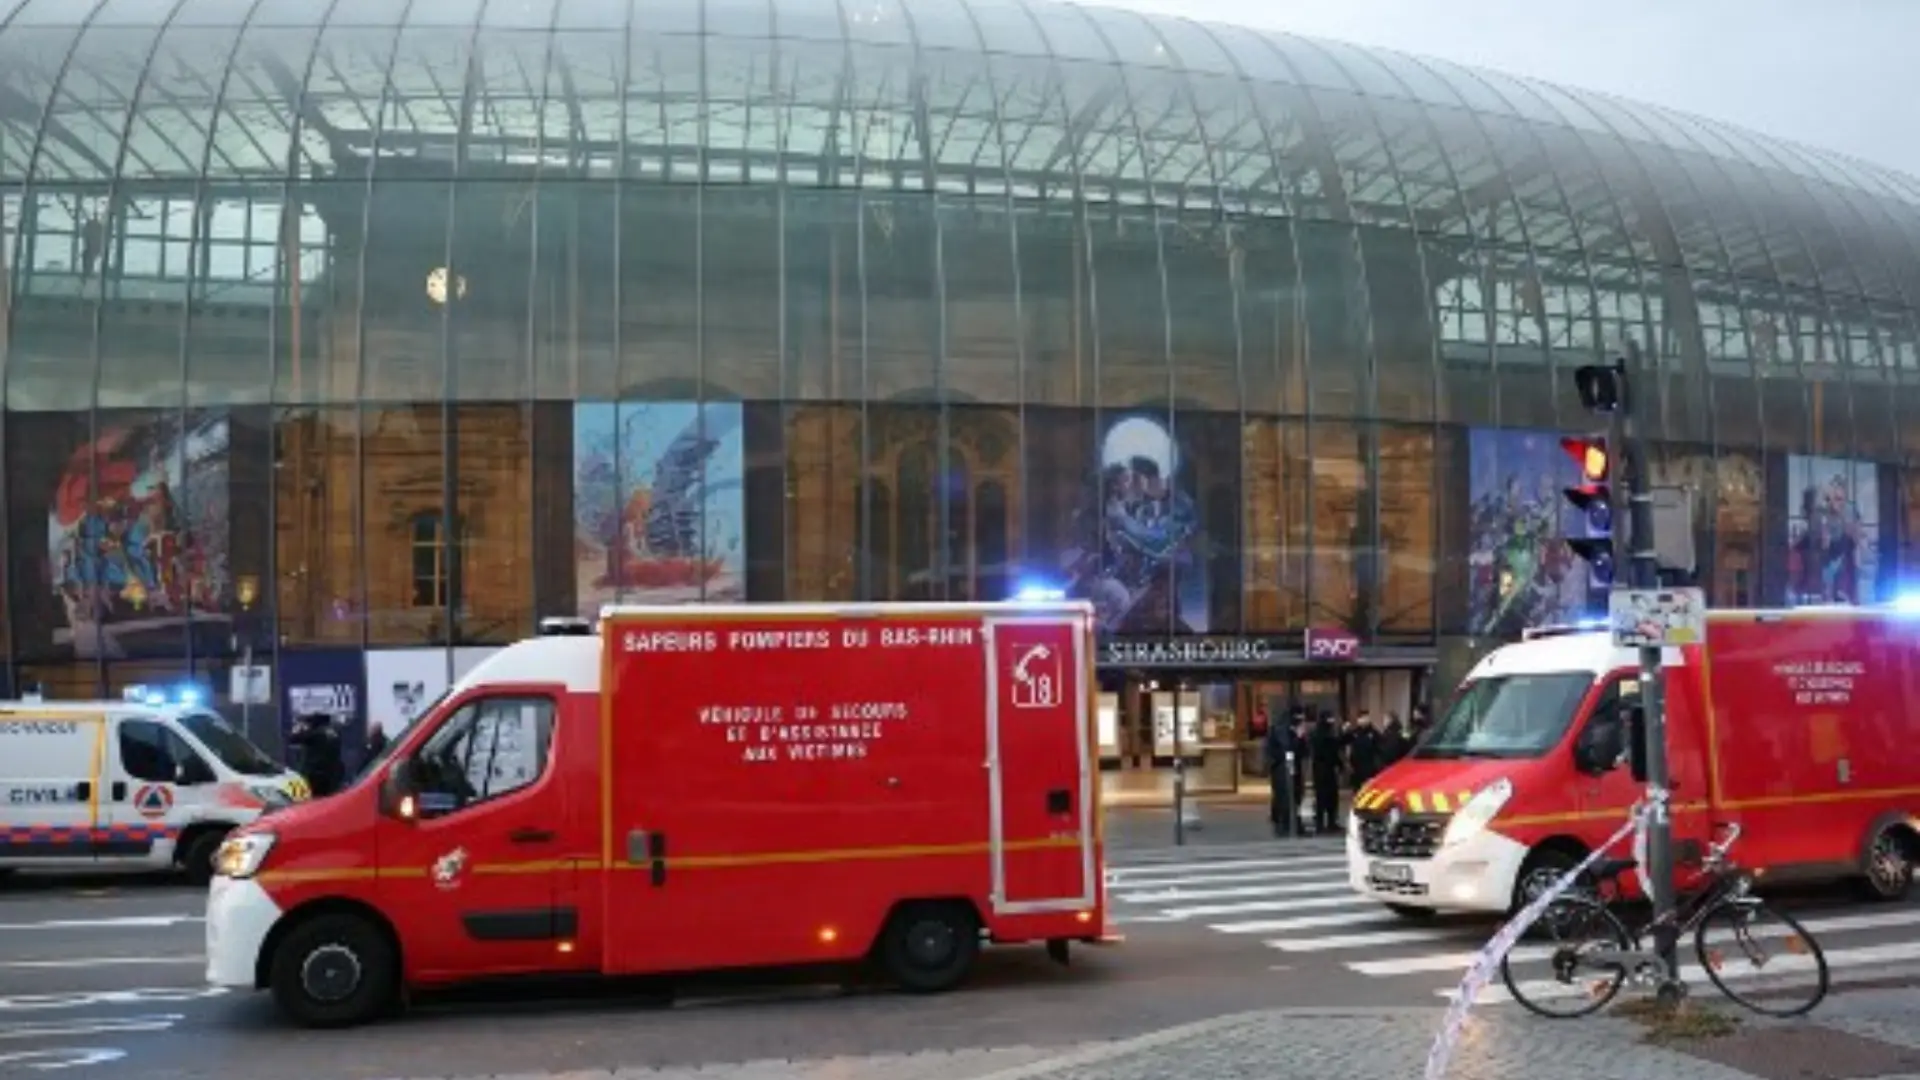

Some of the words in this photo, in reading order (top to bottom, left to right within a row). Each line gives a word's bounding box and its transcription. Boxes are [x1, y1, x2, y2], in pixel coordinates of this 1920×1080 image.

[623, 631, 716, 652] SAPEURS
[729, 629, 830, 650] POMPIERS
[842, 629, 868, 648] DU
[880, 627, 973, 647] BAS-RHIN
[1312, 638, 1357, 656] SNCF
[1109, 638, 1272, 663] STRASBOURG
[1031, 674, 1052, 704] 18
[832, 702, 907, 720] SECOURS
[743, 745, 777, 761] AUX
